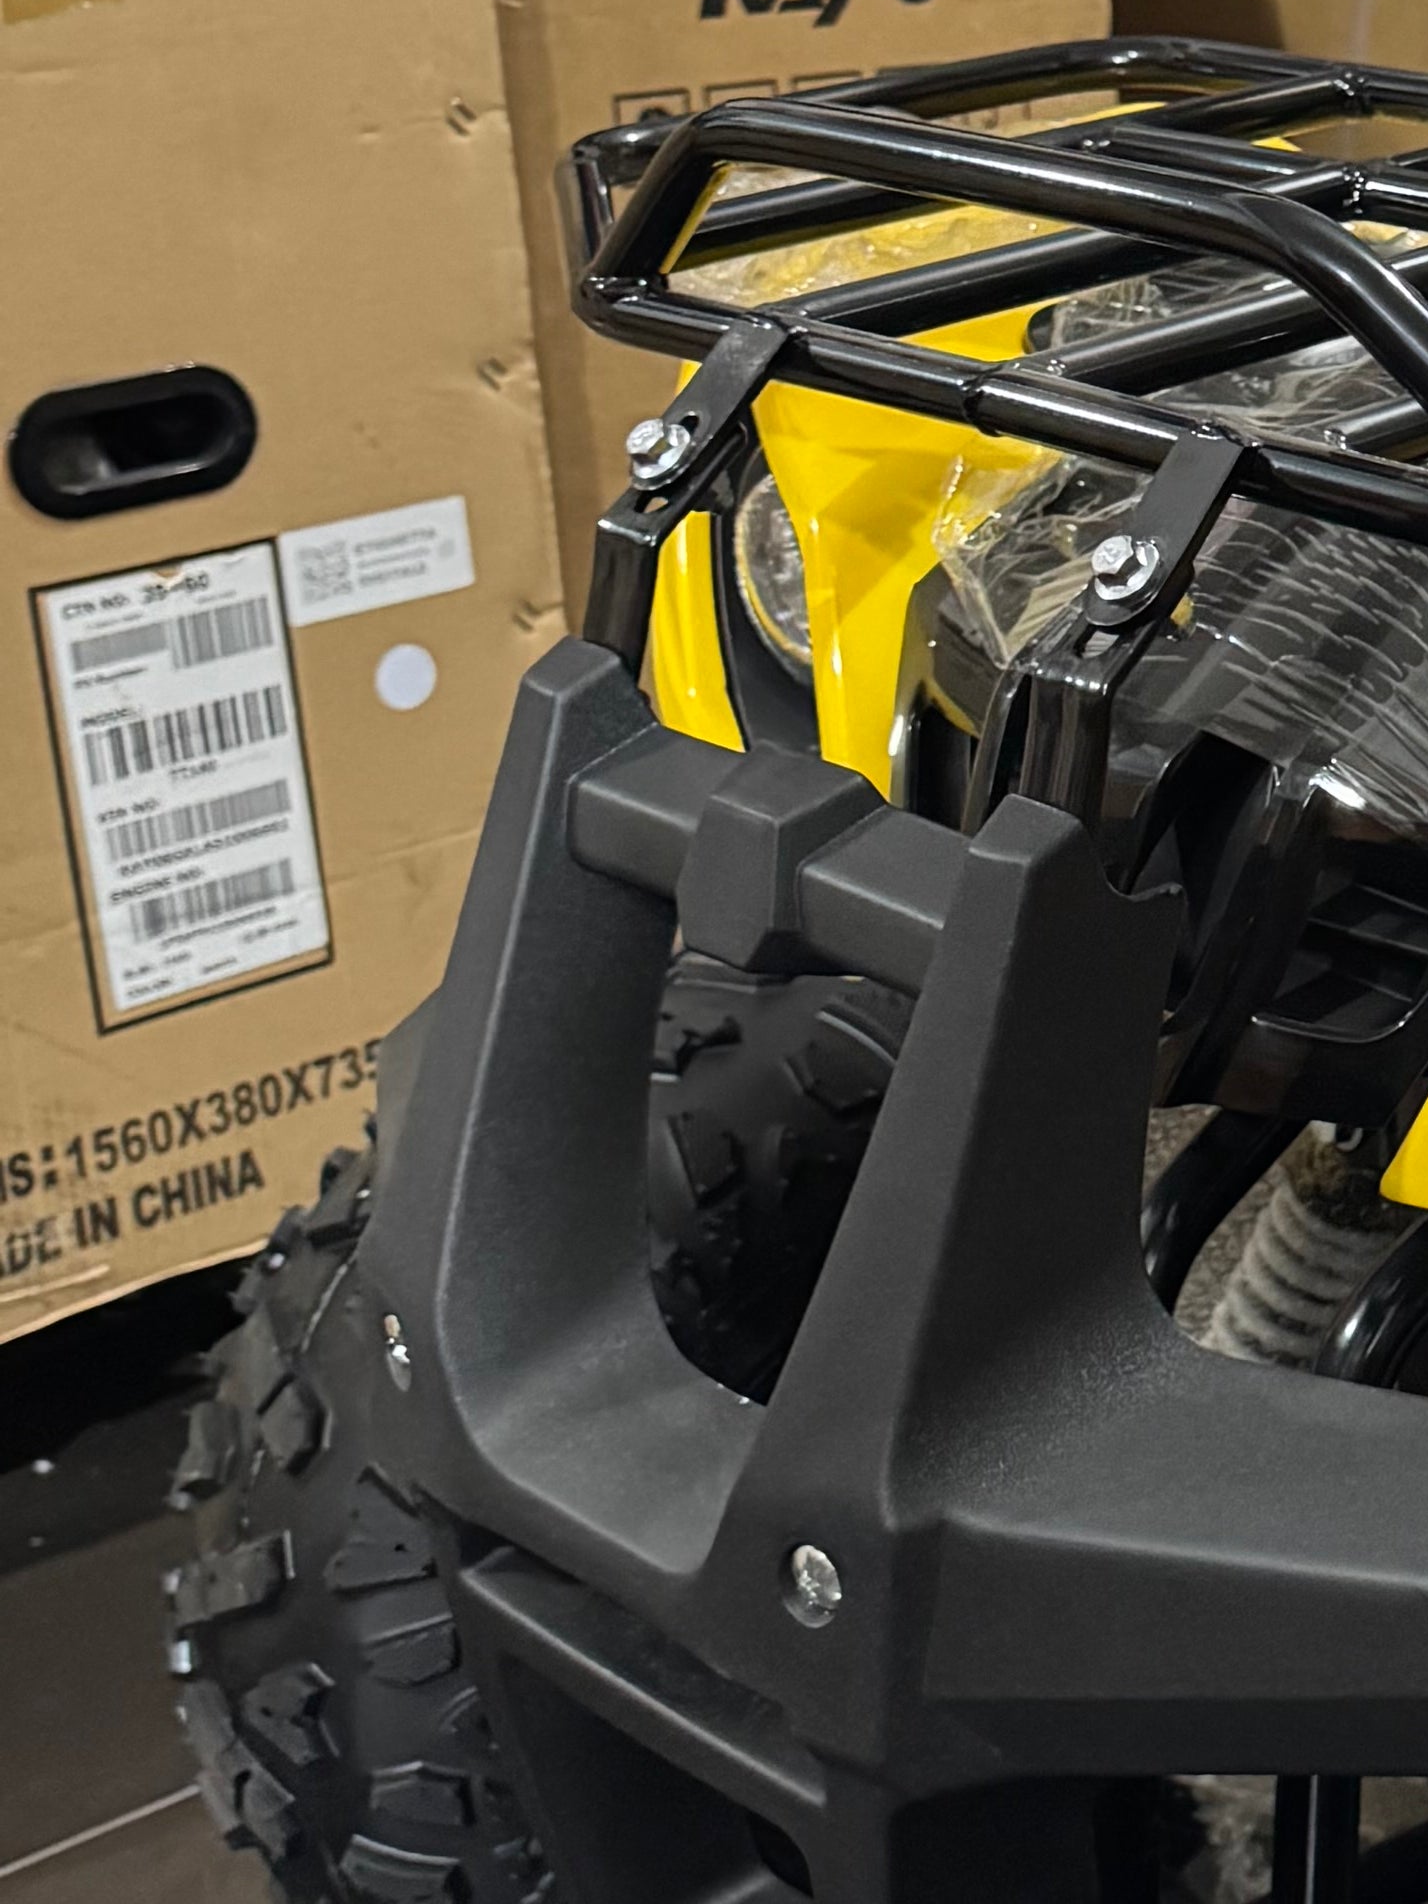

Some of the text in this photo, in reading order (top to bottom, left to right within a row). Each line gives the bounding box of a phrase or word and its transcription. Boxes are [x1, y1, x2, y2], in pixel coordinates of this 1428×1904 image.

[0, 1148, 266, 1278] DE IN CHINA
